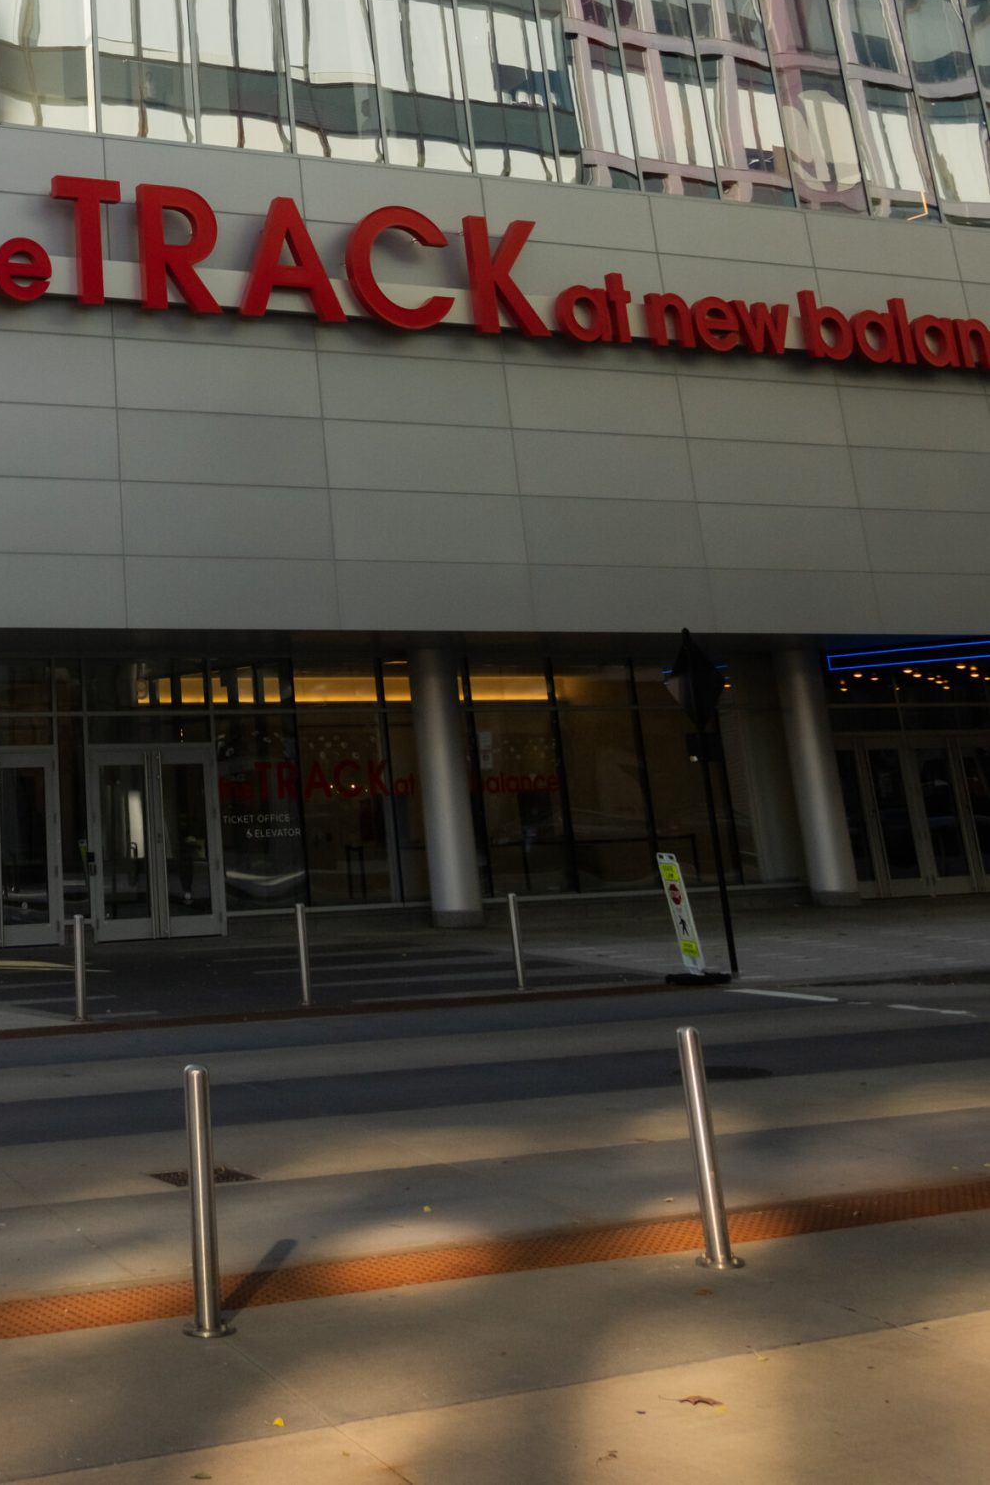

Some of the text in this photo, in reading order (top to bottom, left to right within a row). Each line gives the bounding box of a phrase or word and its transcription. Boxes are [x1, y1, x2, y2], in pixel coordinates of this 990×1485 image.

[50, 175, 552, 337] TRACK
[555, 273, 632, 344] at
[644, 292, 789, 355] new
[254, 759, 388, 802] TRACK
[222, 812, 291, 825] TICKET OFFICE
[254, 827, 301, 838] ELEVATOR
